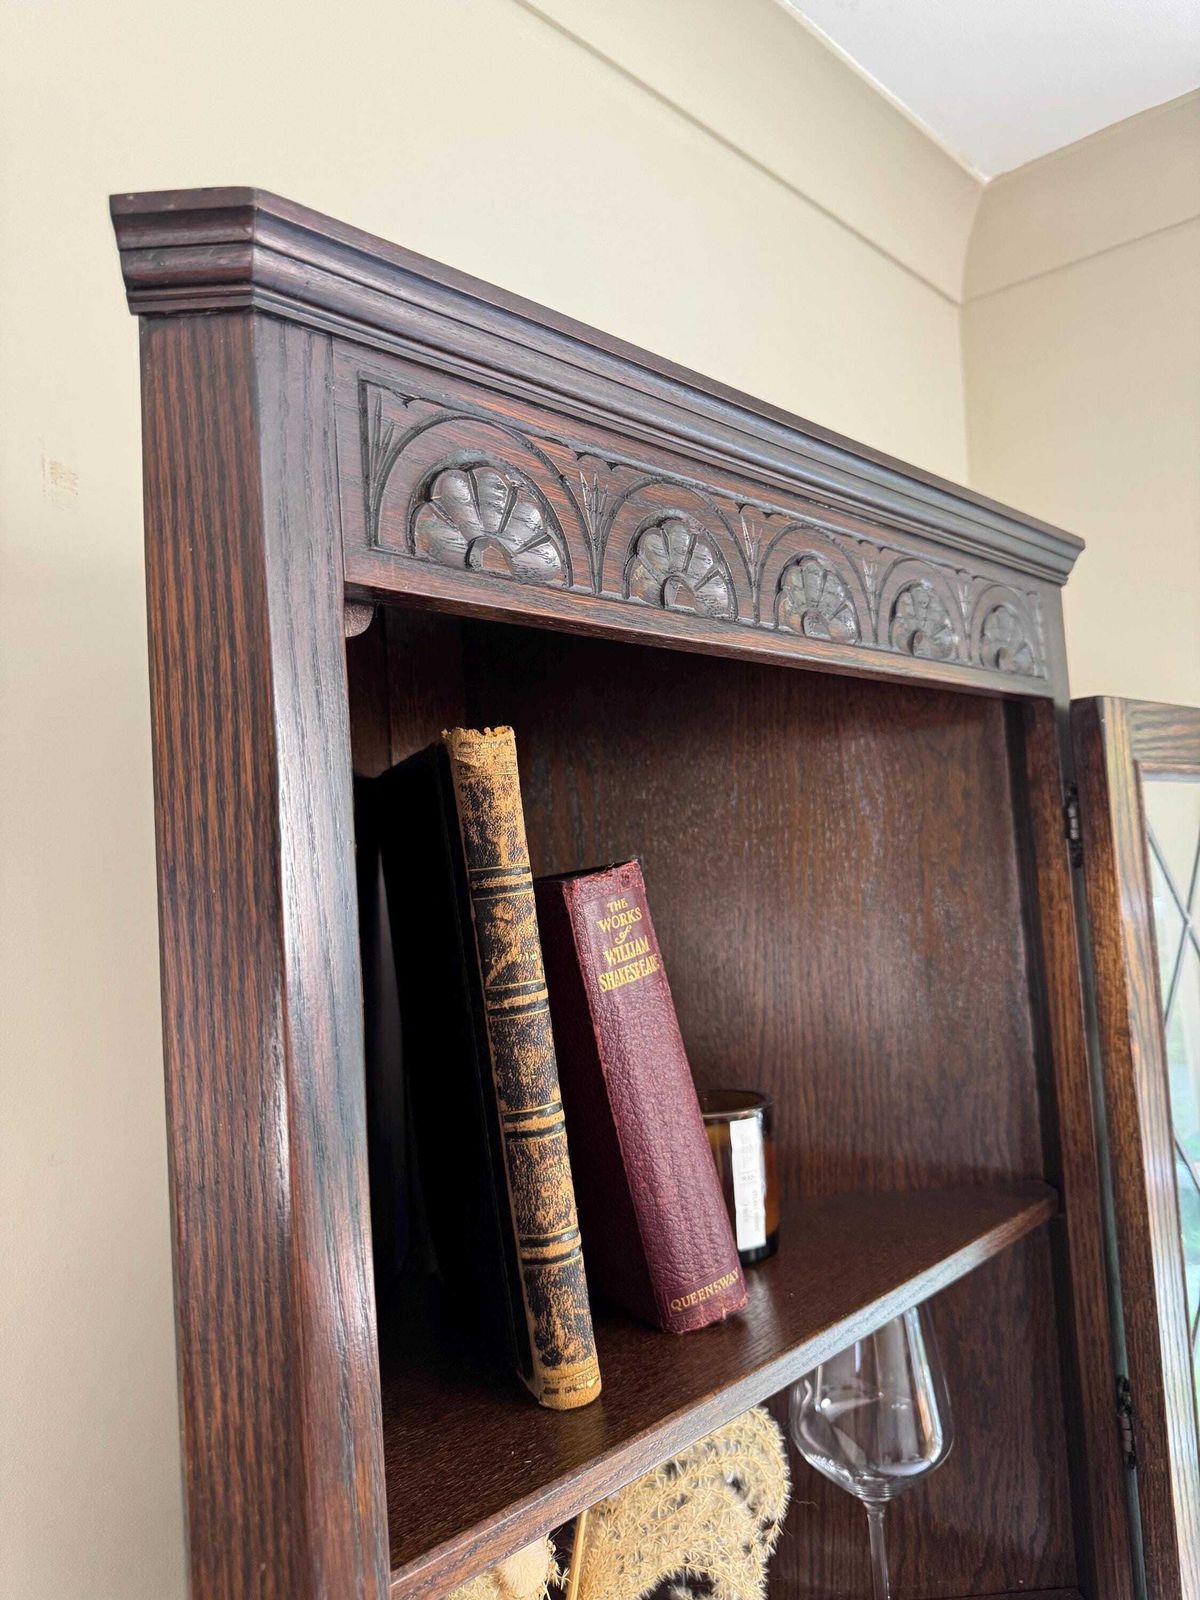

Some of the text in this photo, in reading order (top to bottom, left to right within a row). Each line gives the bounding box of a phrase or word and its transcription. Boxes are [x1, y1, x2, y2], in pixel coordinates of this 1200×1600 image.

[607, 898, 628, 912] THE
[597, 907, 642, 932] WORKS
[615, 925, 631, 944] of
[603, 936, 650, 966] WILLIAM
[671, 1267, 739, 1311] QUEENSWAY
